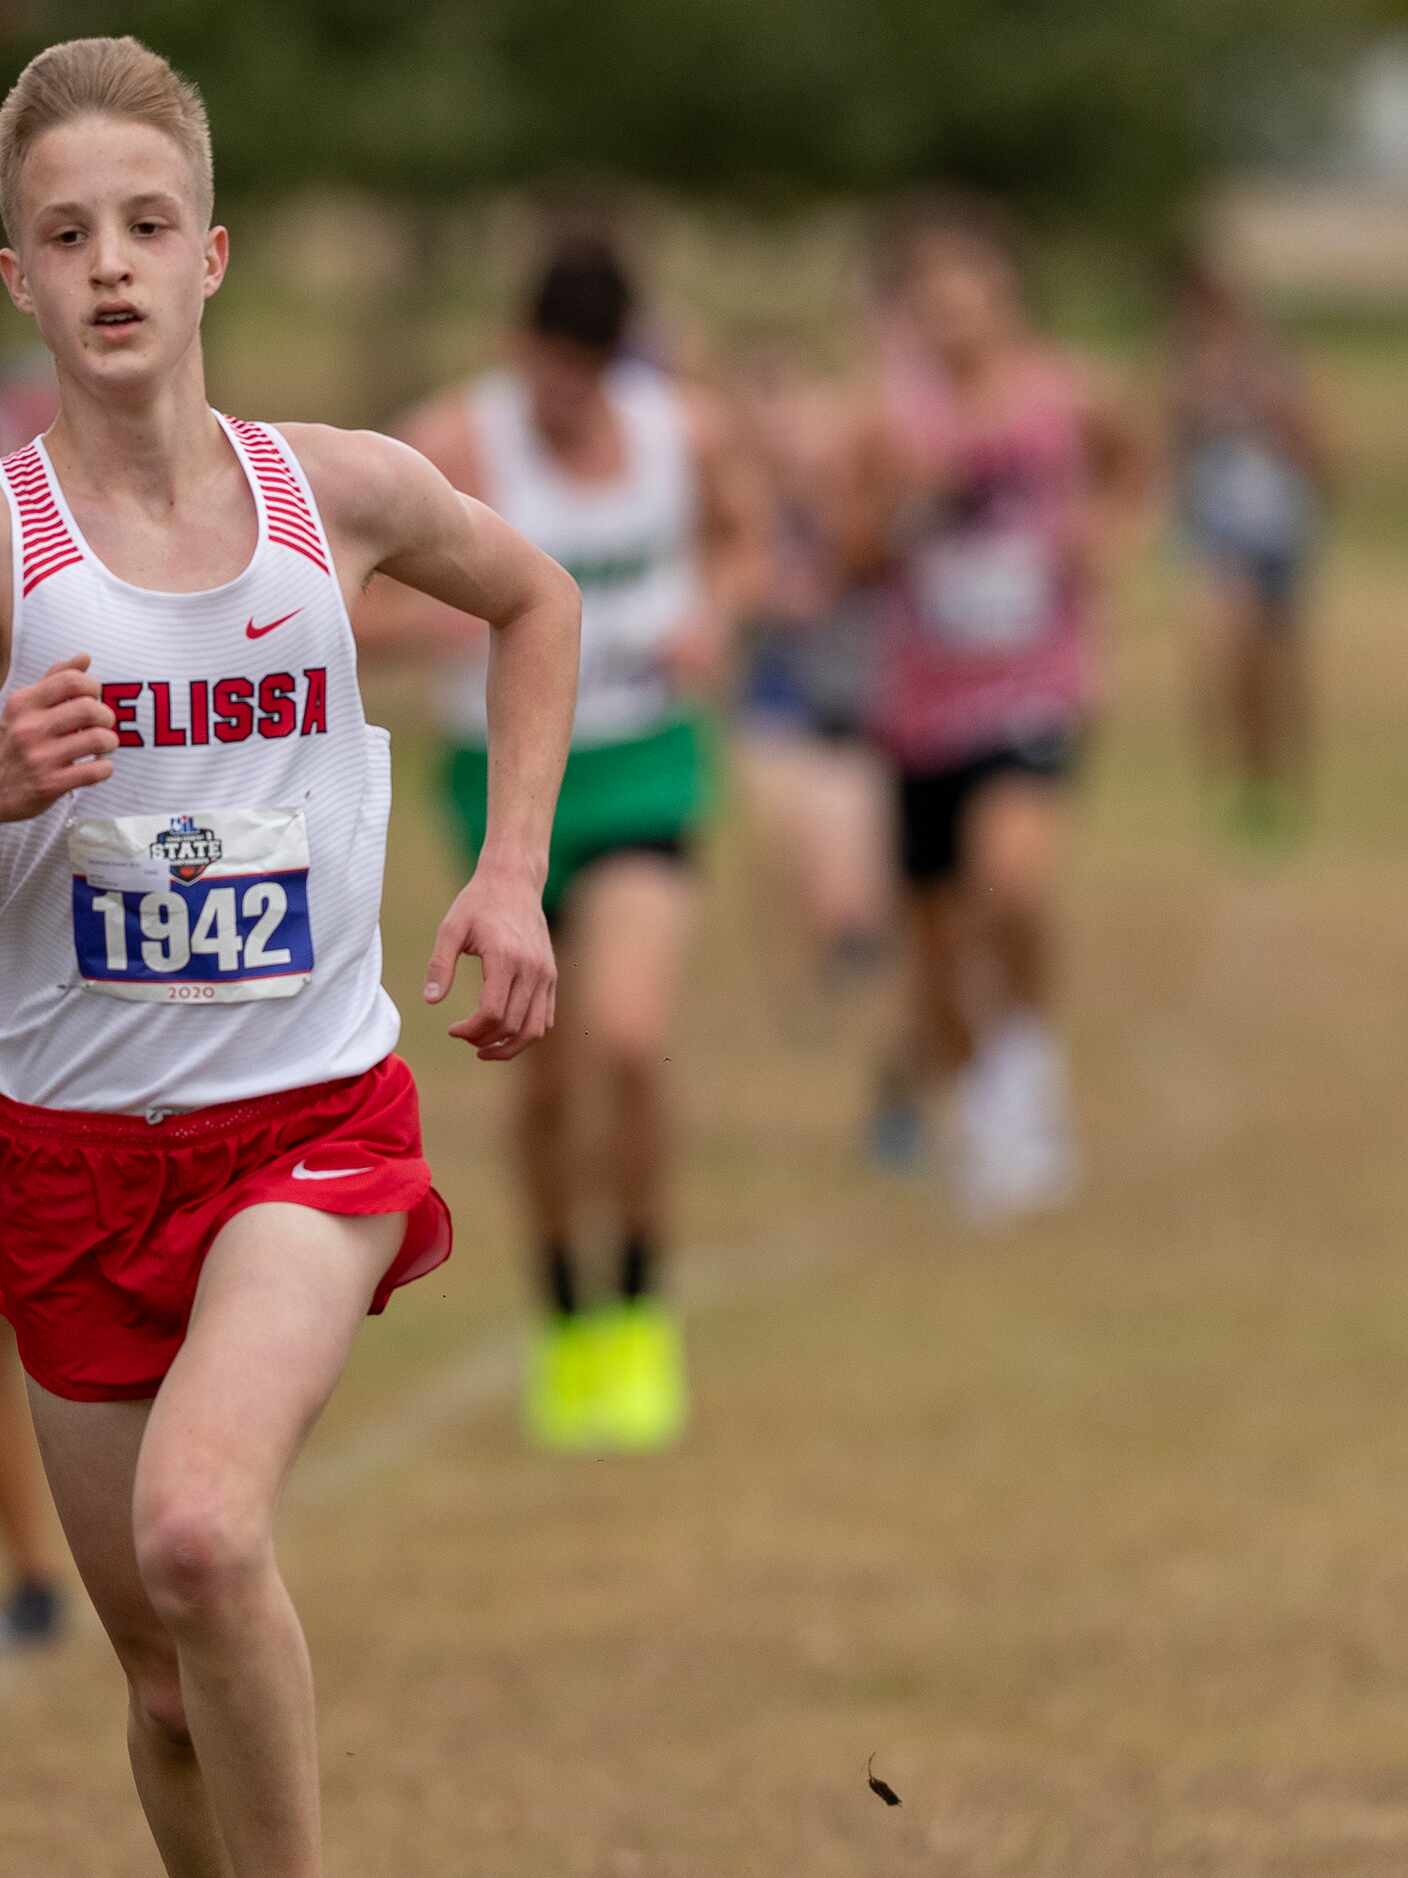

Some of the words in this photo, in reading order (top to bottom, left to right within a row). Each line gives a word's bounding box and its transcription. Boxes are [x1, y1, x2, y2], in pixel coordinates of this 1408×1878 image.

[101, 667, 327, 748] ELISSA
[151, 839, 222, 861] STATE
[91, 881, 292, 973] 1942
[168, 985, 216, 999] 2020
